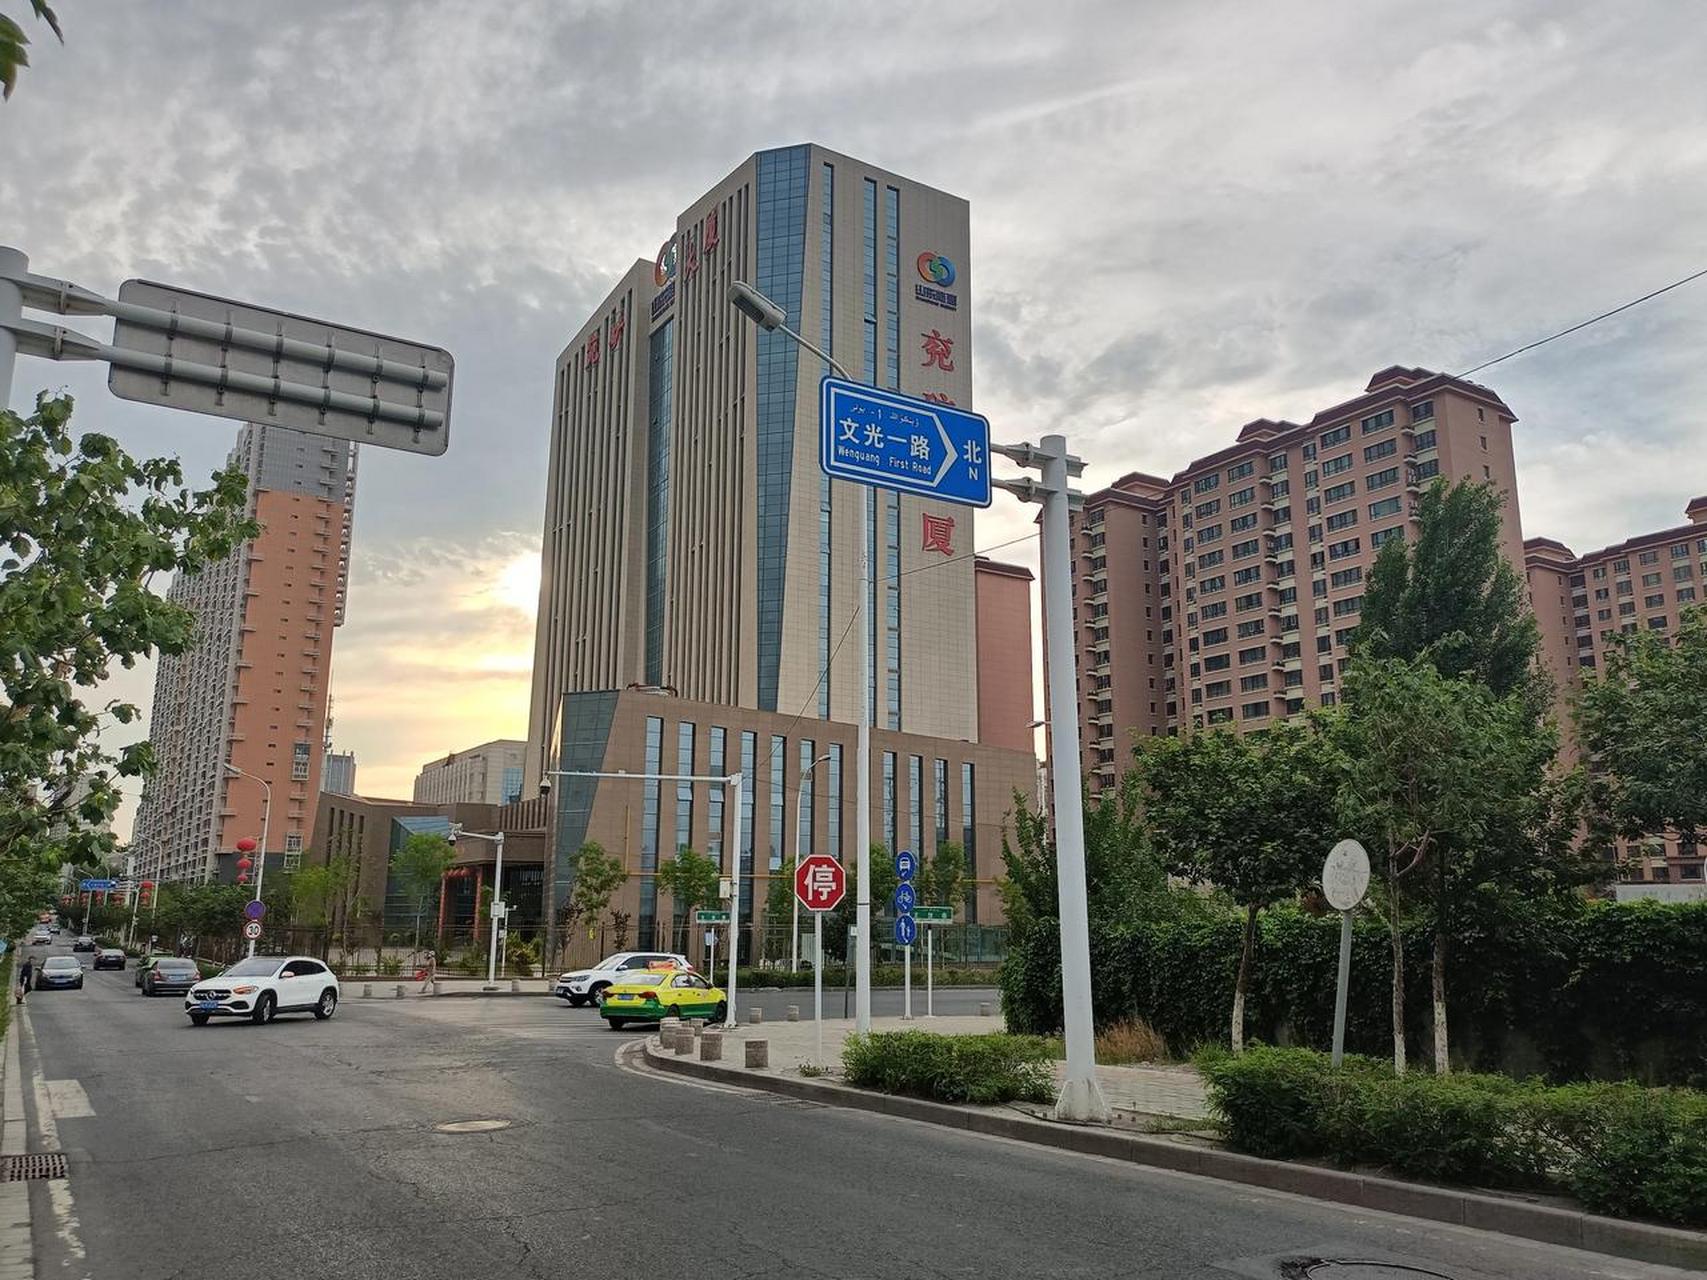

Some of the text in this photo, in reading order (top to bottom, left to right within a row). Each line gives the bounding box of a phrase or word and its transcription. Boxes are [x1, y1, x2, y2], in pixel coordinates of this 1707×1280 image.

[839, 417, 930, 461] 文光一路
[963, 439, 982, 465] 北
[838, 445, 931, 476] Wenguang First Road
[968, 467, 979, 481] N
[804, 864, 836, 901] 停
